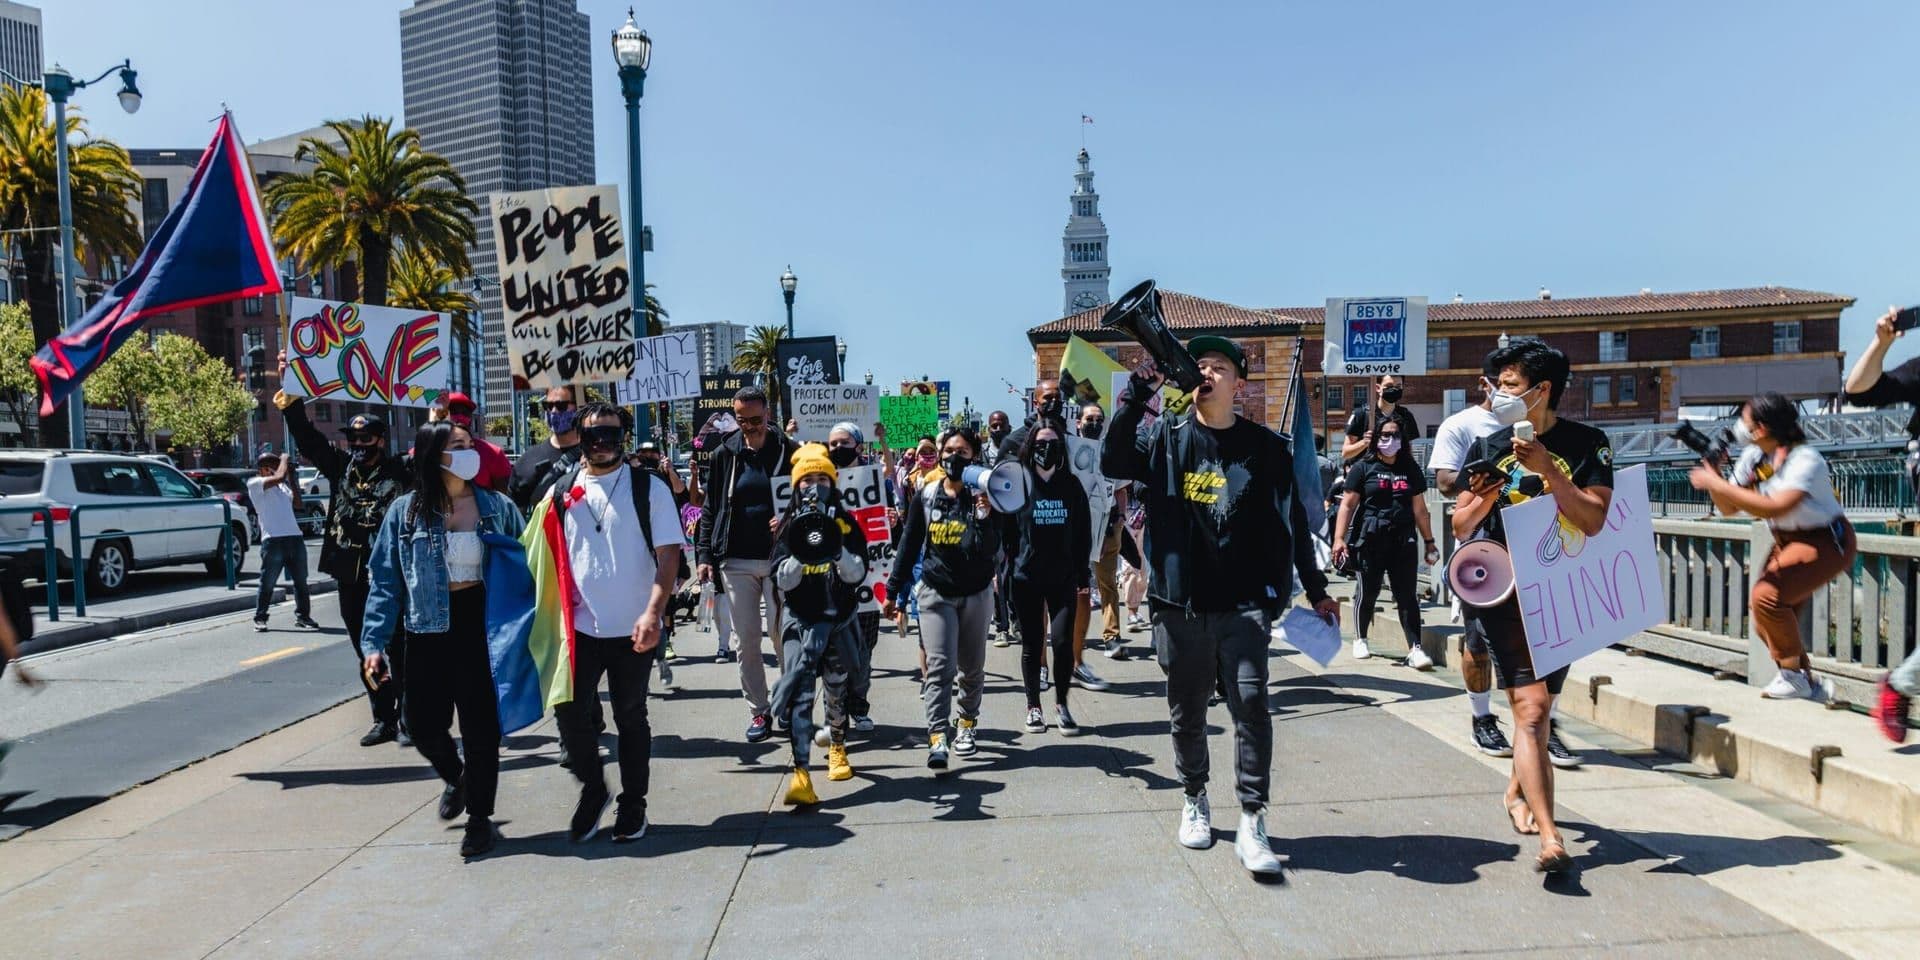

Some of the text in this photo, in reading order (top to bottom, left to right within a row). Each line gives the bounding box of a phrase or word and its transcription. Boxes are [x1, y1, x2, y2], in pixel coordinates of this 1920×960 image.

[500, 195, 624, 265] PEOPLE
[1357, 305, 1394, 318] 8BY8
[557, 307, 634, 348] NEVER
[1353, 332, 1397, 345] ASIAN
[1355, 344, 1394, 356] HATE
[290, 313, 442, 405] LOVE
[652, 358, 669, 374] IN
[618, 370, 691, 402] HUMANITY
[705, 379, 741, 390] WE ARE
[794, 388, 868, 400] PROTECT OUR
[699, 399, 734, 409] STRONGE
[888, 396, 917, 406] BLM
[800, 403, 869, 415] COMMUNITY
[882, 415, 912, 423] HATE
[887, 422, 937, 434] STRONGER
[1522, 550, 1645, 648] UNITE
